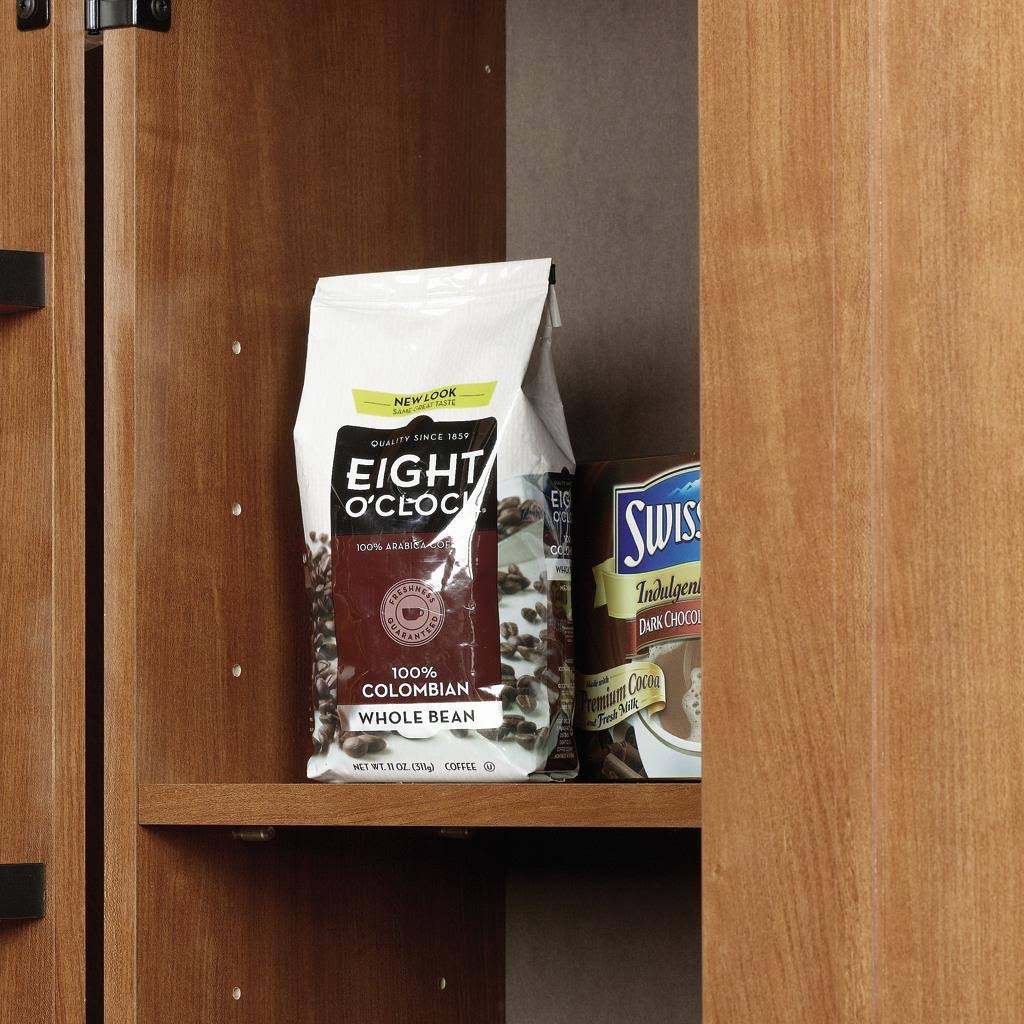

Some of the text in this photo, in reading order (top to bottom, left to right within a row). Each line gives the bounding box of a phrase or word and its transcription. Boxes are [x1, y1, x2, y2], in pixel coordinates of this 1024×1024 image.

[394, 387, 457, 407] NEW LOOK
[371, 432, 469, 448] QUALITY SINCE 1859
[346, 450, 485, 491] EIGHT
[356, 542, 426, 552] 100% ARABICA
[389, 585, 436, 606] FRESHNESS
[386, 615, 438, 641] GUARANTEED
[639, 610, 701, 636] DARK CHOCOL
[391, 666, 438, 680] 100%
[362, 682, 469, 698] COLOMBIAN
[628, 673, 660, 695] Cocoa
[358, 709, 475, 724] WHOLE BEAN
[598, 708, 618, 729] Fresh
[353, 762, 477, 771] NET COFFEE
